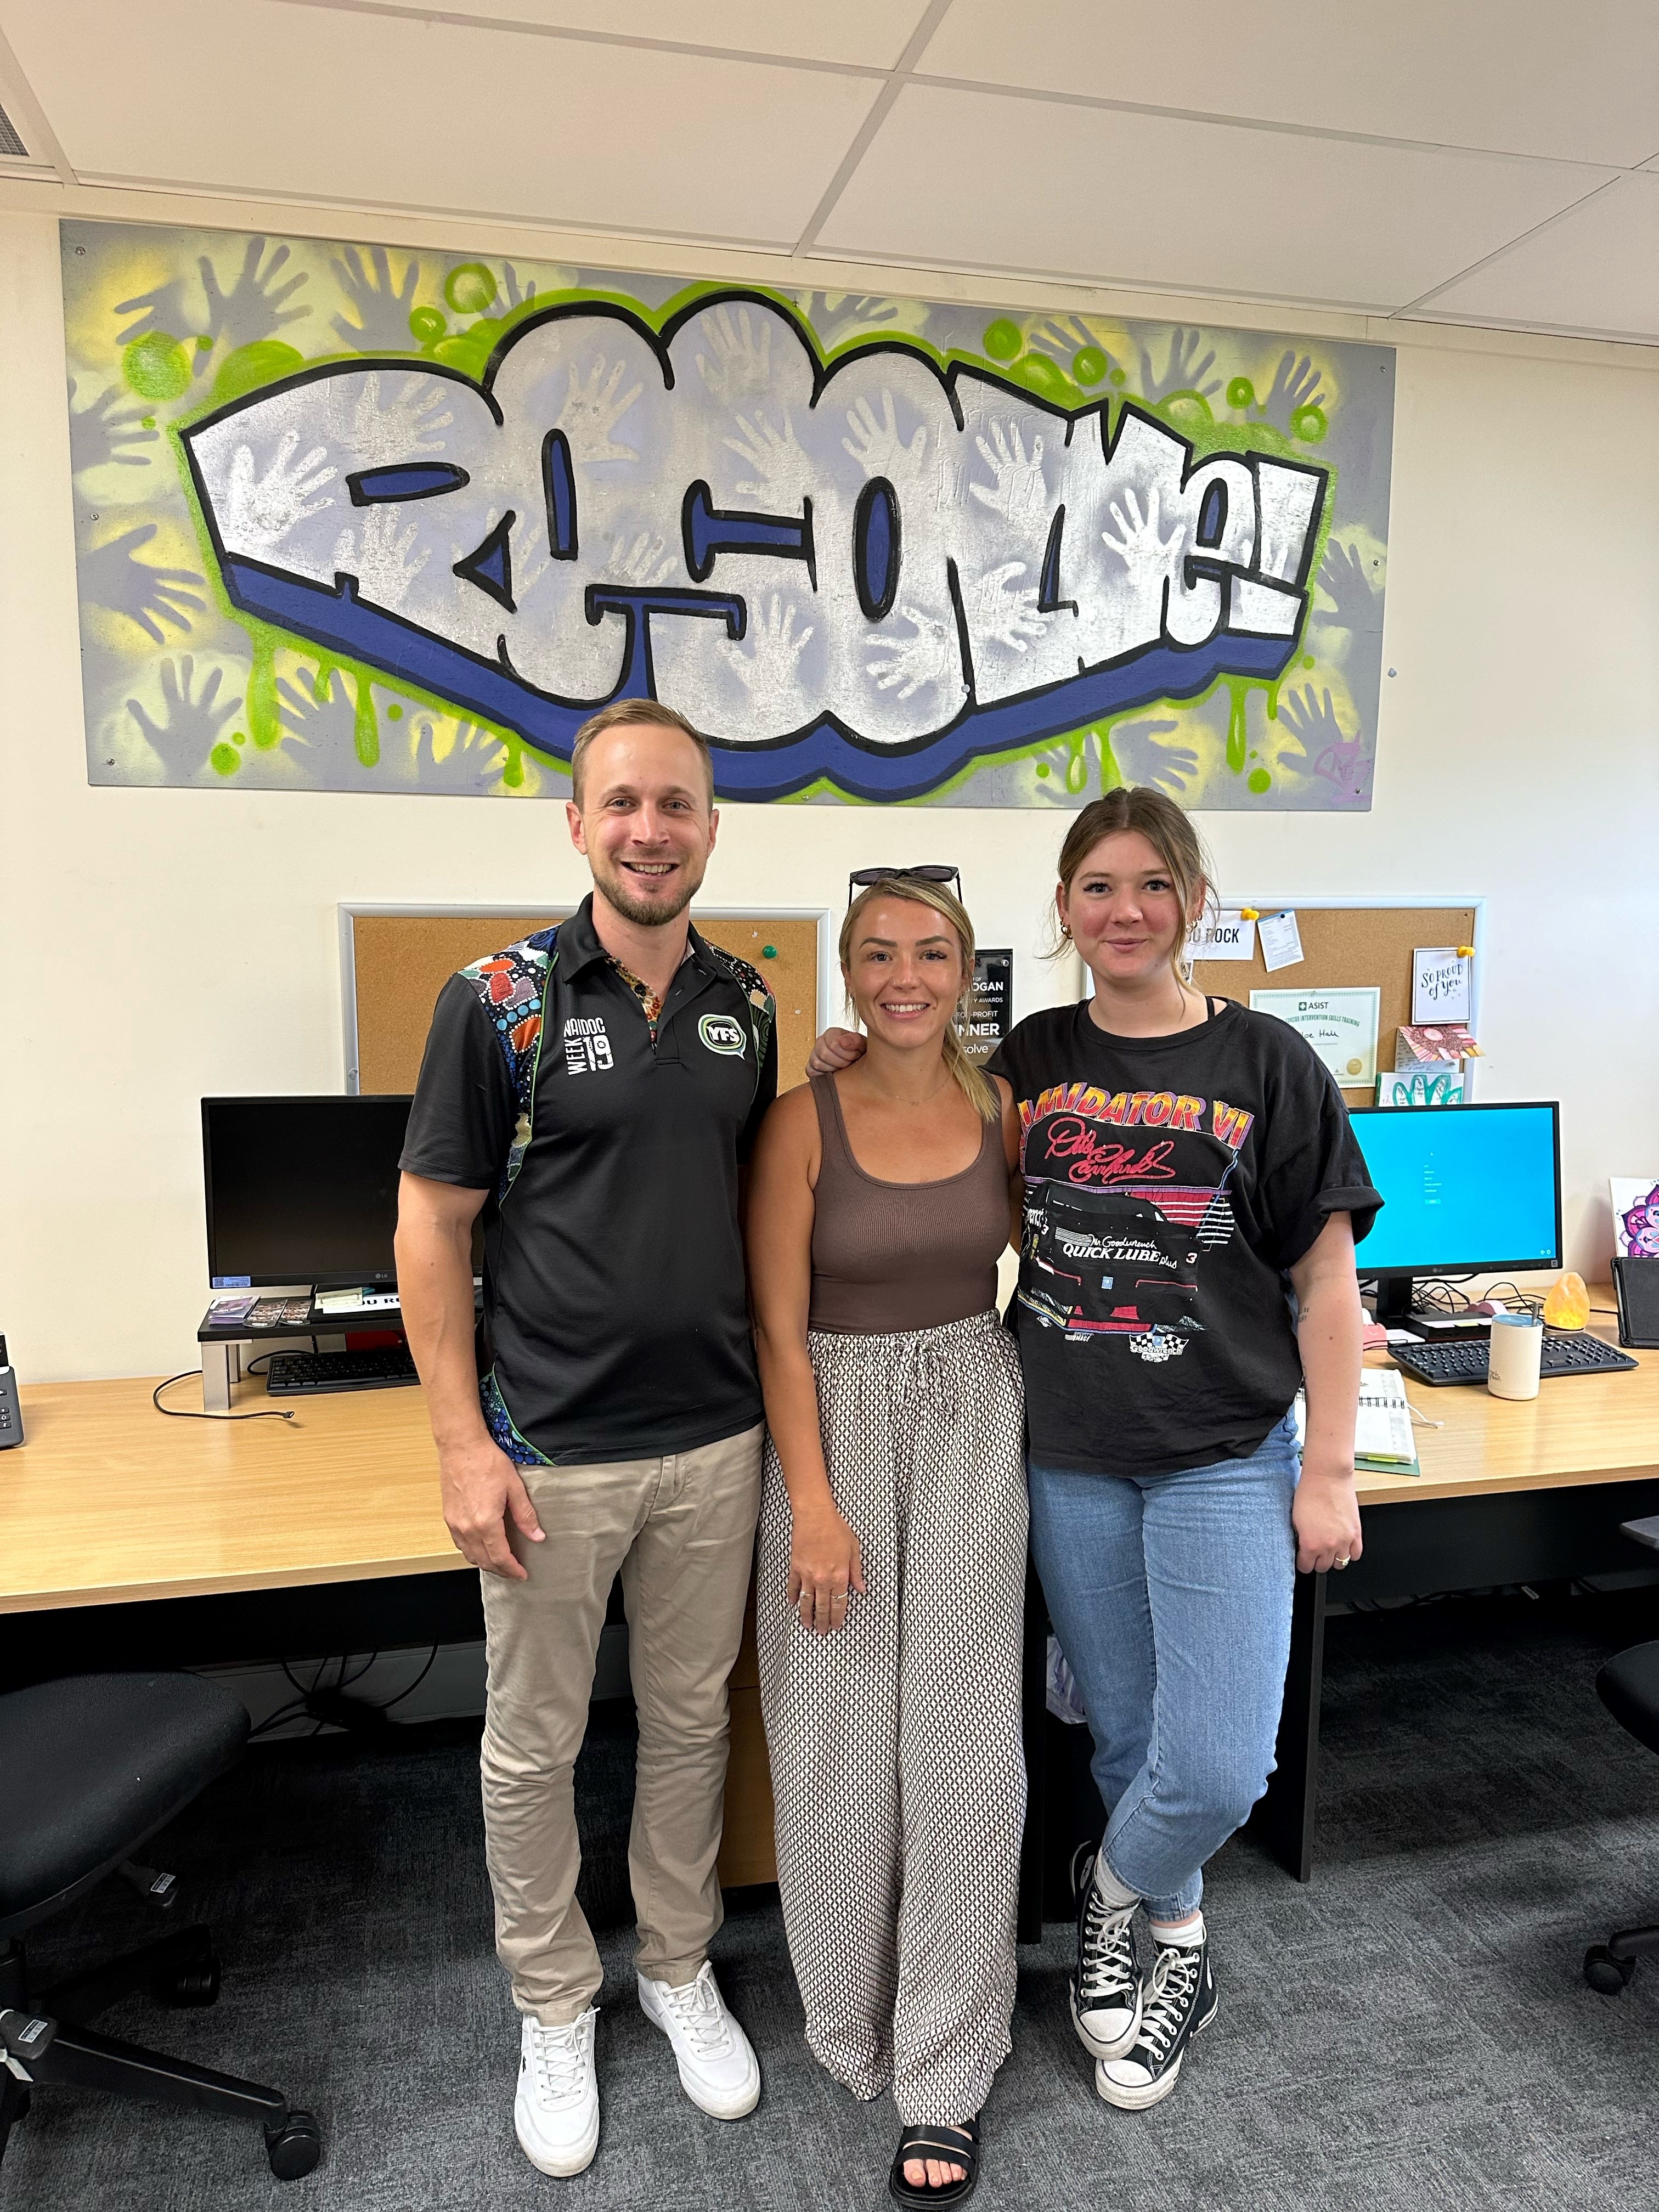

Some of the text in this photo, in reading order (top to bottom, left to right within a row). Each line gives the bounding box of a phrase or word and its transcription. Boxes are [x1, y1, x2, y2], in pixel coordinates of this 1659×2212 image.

[1421, 964, 1463, 988] SO PROUD
[973, 981, 1003, 991] OGAN
[1429, 983, 1439, 1001] of
[564, 1017, 606, 1037] NAIDOC
[955, 1023, 1000, 1036] INNER
[1341, 1017, 1361, 1027] TRAINING
[706, 1026, 740, 1043] YFS
[564, 1037, 588, 1075] WEEK
[582, 1035, 614, 1071] 19
[963, 1043, 989, 1054] solve
[1212, 1101, 1255, 1150] VI
[1102, 1235, 1157, 1249] Goodwrench
[1063, 1244, 1178, 1269] QUICK LUBE plus
[1186, 1252, 1198, 1264] 3
[1130, 1345, 1182, 1355] Goodwrench
